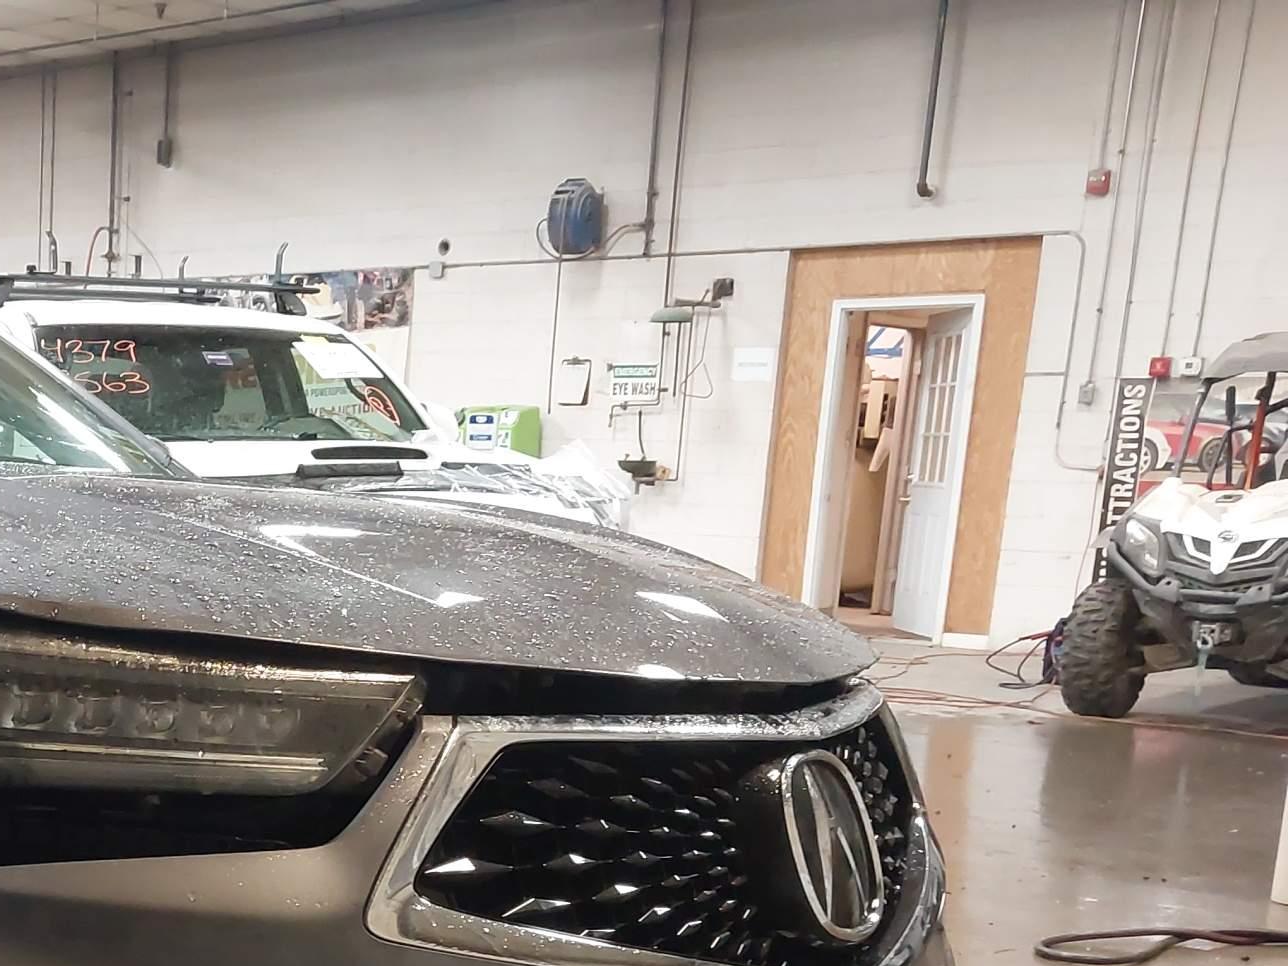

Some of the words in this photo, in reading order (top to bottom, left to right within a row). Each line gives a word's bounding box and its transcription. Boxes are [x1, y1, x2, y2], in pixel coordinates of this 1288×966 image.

[40, 338, 137, 364] 4379
[64, 371, 151, 395] 563
[612, 382, 629, 396] EYE
[631, 382, 657, 396] WASH
[1106, 384, 1146, 525] TTRACTIONS
